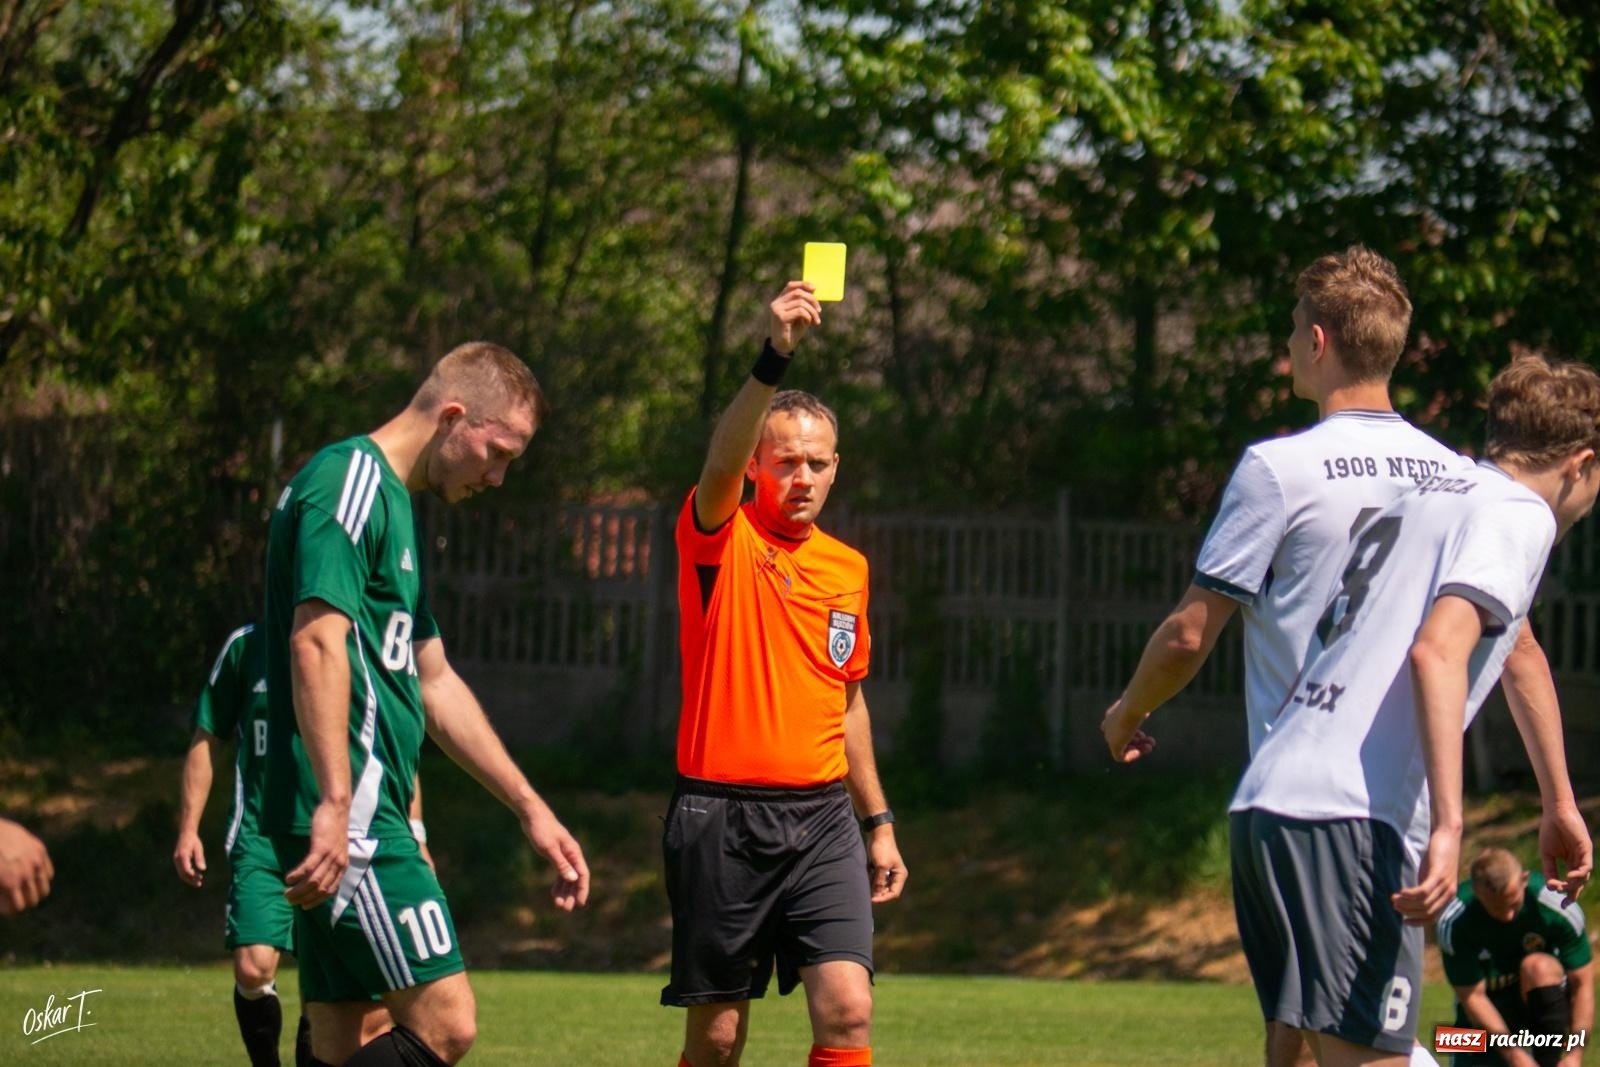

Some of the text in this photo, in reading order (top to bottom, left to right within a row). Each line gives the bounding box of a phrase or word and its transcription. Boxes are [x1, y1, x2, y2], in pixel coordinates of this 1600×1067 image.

[1323, 456, 1377, 480] 1908
[1418, 476, 1478, 496] ĘDZA
[398, 900, 452, 960] 10
[1378, 976, 1412, 1031] 8
